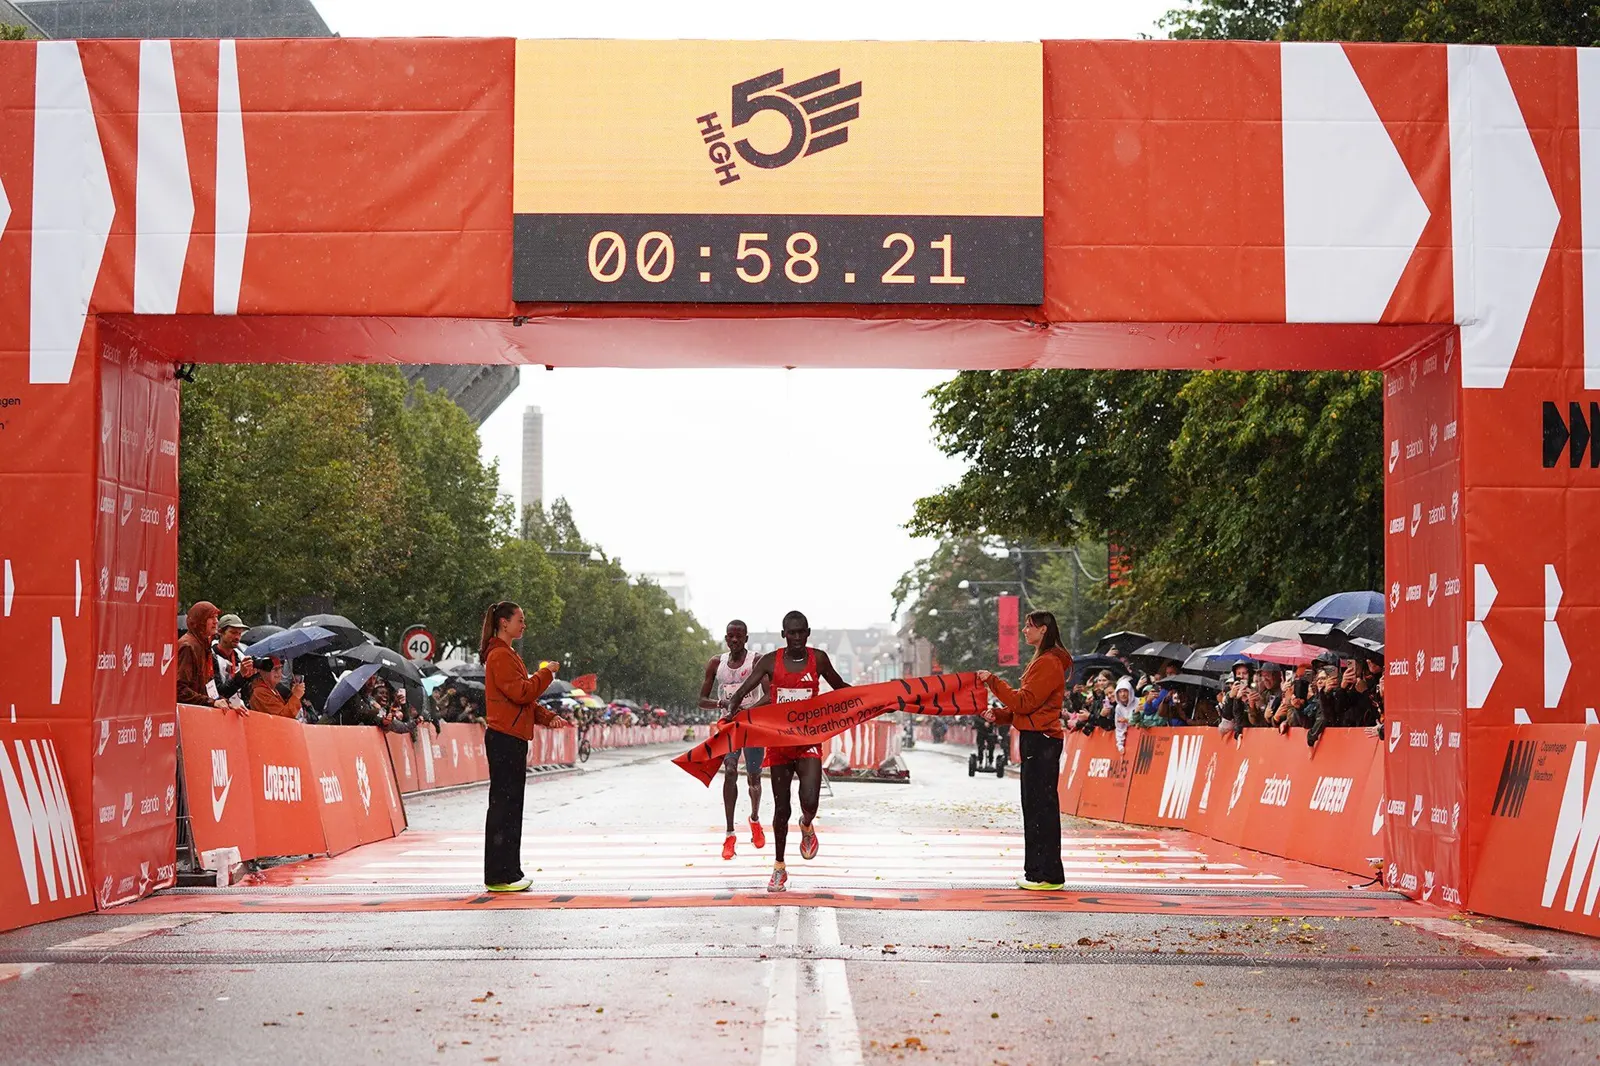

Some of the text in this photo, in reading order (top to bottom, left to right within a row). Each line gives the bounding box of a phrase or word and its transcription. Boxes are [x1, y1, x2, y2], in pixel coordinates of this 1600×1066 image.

[696, 68, 807, 186] HIGH 5
[588, 231, 966, 284] 00:58.21
[0, 398, 21, 408] gen
[409, 640, 429, 653] 40
[787, 697, 864, 723] Copenhagen
[796, 715, 856, 737] Marathon
